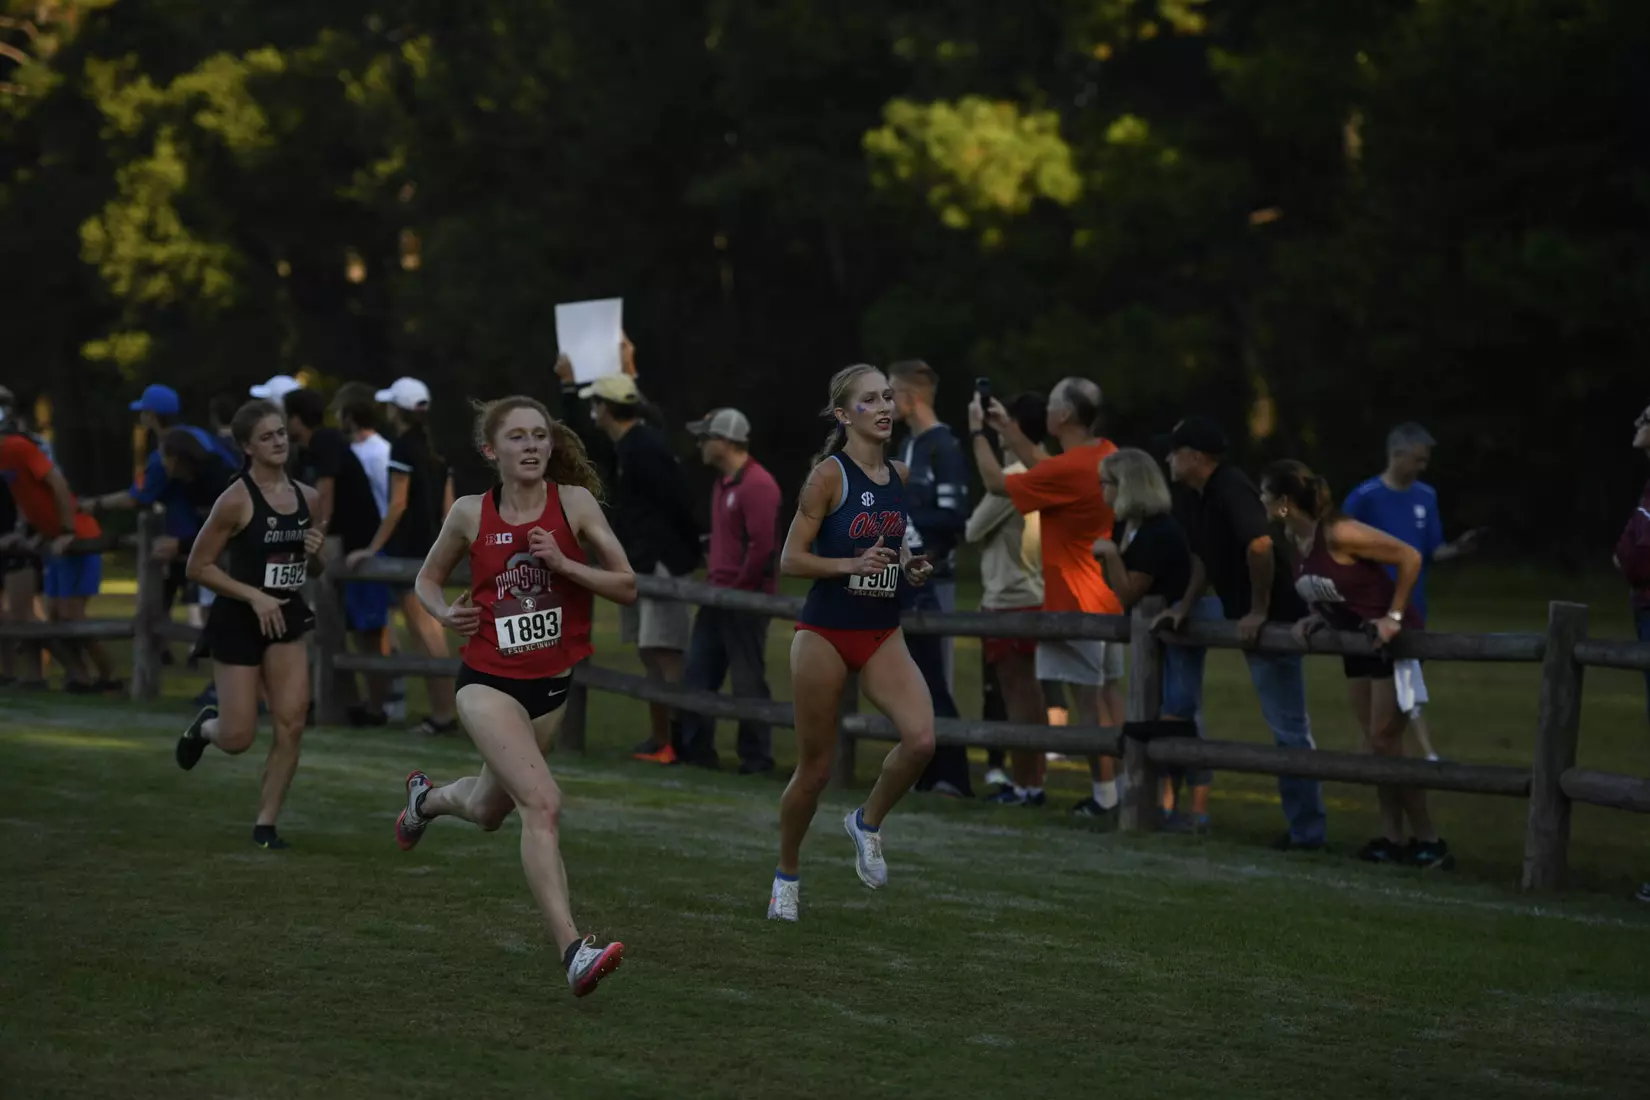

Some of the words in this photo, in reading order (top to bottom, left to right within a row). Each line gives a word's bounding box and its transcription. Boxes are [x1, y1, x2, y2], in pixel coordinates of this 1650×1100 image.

[860, 490, 875, 507] SEC
[849, 511, 878, 539] Ole
[485, 532, 513, 546] BIG
[271, 564, 304, 585] 1592
[504, 611, 559, 645] 1893
